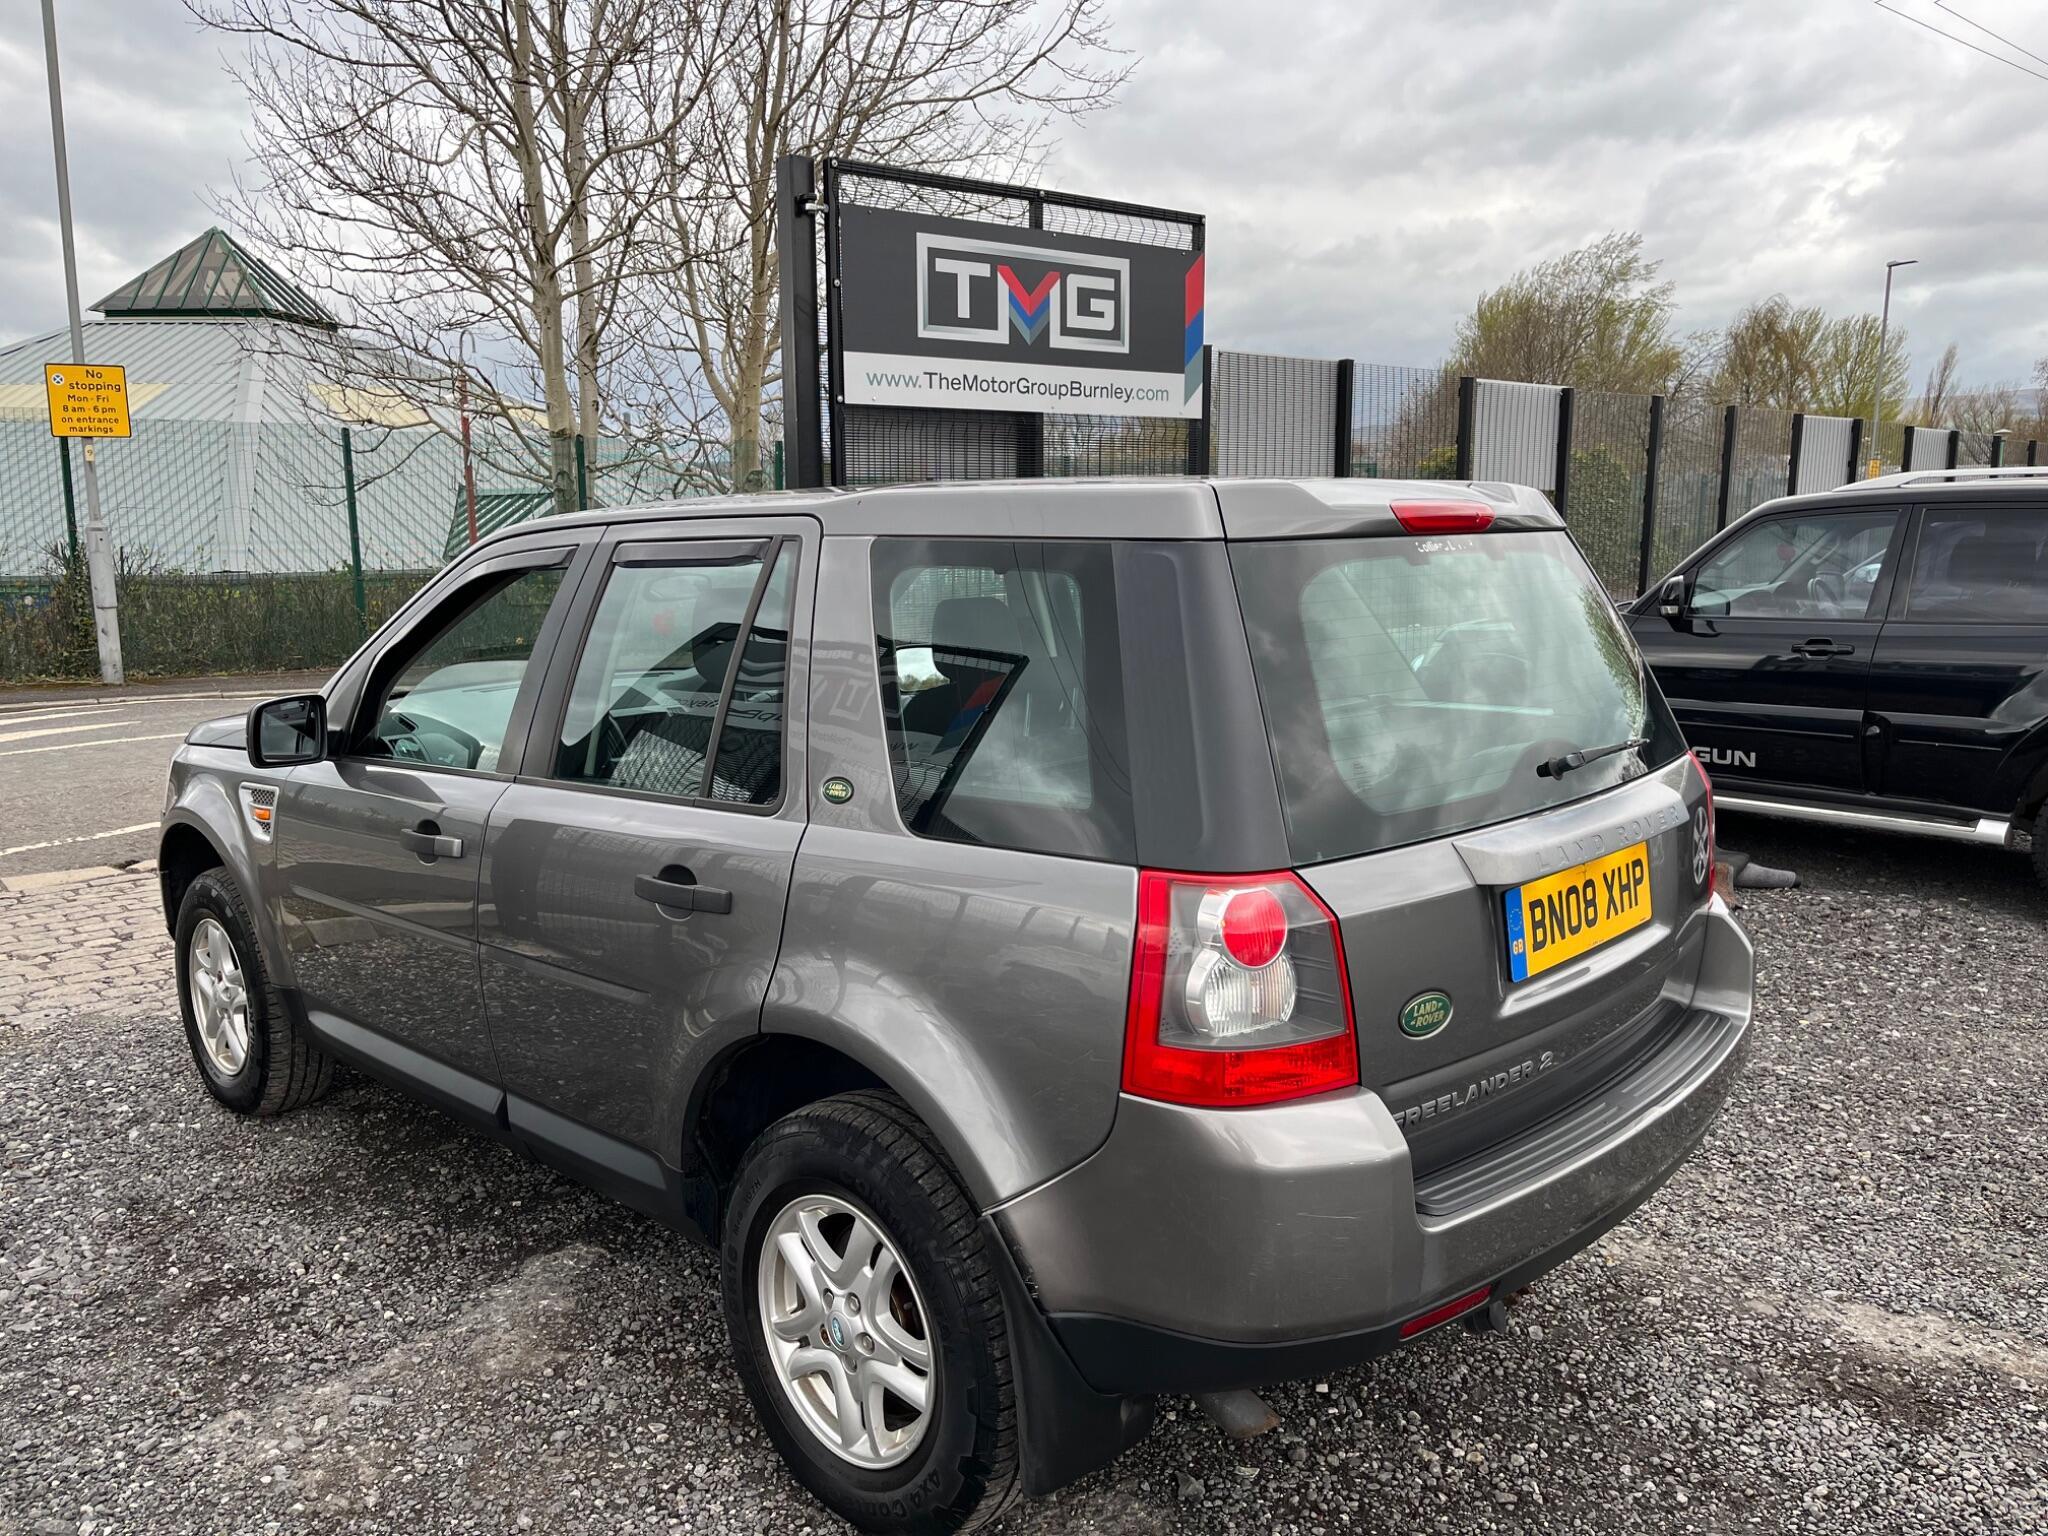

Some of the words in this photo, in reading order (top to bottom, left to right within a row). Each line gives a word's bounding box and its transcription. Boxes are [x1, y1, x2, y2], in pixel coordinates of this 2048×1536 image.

[935, 257, 1116, 346] TMG
[85, 369, 103, 379] No
[69, 381, 121, 392] stopping
[865, 371, 1169, 402] www.TheMotorGroupBurnley.com
[67, 394, 88, 402] Mon
[76, 416, 120, 424] entrance
[69, 425, 114, 434] markings
[1536, 833, 1606, 873] LAND
[1615, 805, 1680, 846] ROVER
[1528, 878, 1599, 953] BN08
[1602, 857, 1645, 921] XHP
[1512, 938, 1524, 955] GB
[1413, 1000, 1438, 1018] LAND
[1415, 1010, 1445, 1028] ROVER
[1392, 1060, 1534, 1130] FREELANDER
[1538, 1050, 1554, 1071] 2
